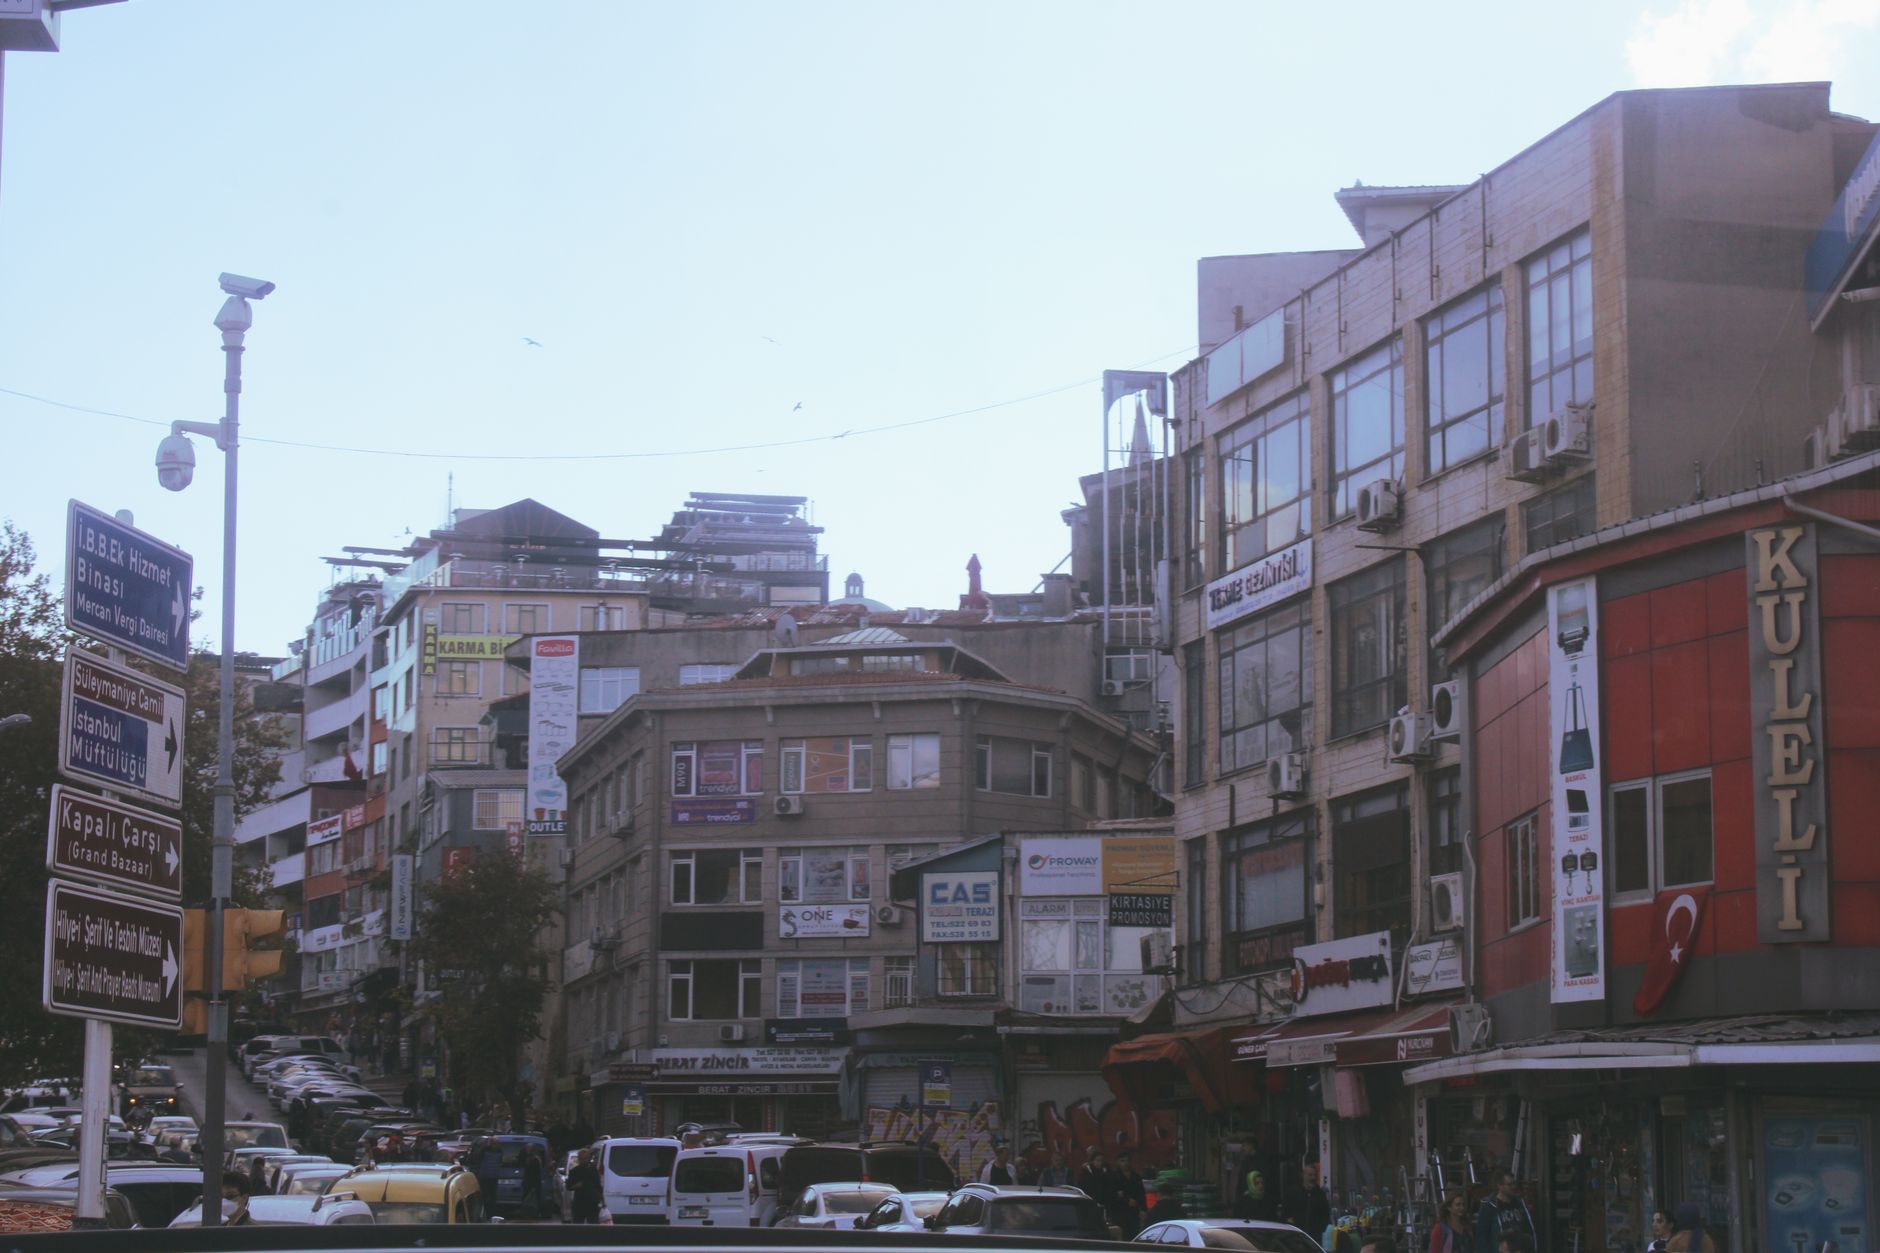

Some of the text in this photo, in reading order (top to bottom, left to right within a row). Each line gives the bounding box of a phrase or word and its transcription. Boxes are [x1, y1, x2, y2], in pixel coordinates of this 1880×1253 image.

[77, 558, 124, 598] Binası
[129, 547, 172, 588] Hizmet
[1209, 578, 1242, 611] TEKNE
[1246, 549, 1296, 596] GEZİNTİSİ
[77, 592, 168, 646] Mercan Vergi Dairesi
[425, 625, 435, 674] KARMA
[439, 642, 486, 655] KARMA
[74, 664, 164, 716] Süleymaniye Camii
[73, 700, 122, 743] İstanbul
[71, 735, 147, 781] Müftülüğü
[700, 784, 738, 793] trendyol
[61, 801, 161, 855] Kapalı Çarşı
[707, 813, 741, 823] trendyol
[68, 842, 153, 880] (Grand Bazaar)
[1049, 857, 1098, 866] PROWAY
[931, 882, 991, 904] CAS
[1028, 904, 1066, 913] ALARM
[1111, 896, 1169, 909] KIRTASİYE
[55, 909, 162, 958] Hilye-i Şerif Ve Tesbih Müzesi
[801, 910, 832, 921] ONE
[1111, 911, 1169, 925] PROMOSYON
[77, 963, 90, 998] Şerif
[90, 966, 103, 993] And
[103, 968, 121, 1002] Prayer
[121, 972, 137, 999] Beads
[138, 974, 161, 1004] Museum)
[656, 1053, 750, 1070] BERAT ZİNCİR
[698, 1086, 731, 1094] BERAT
